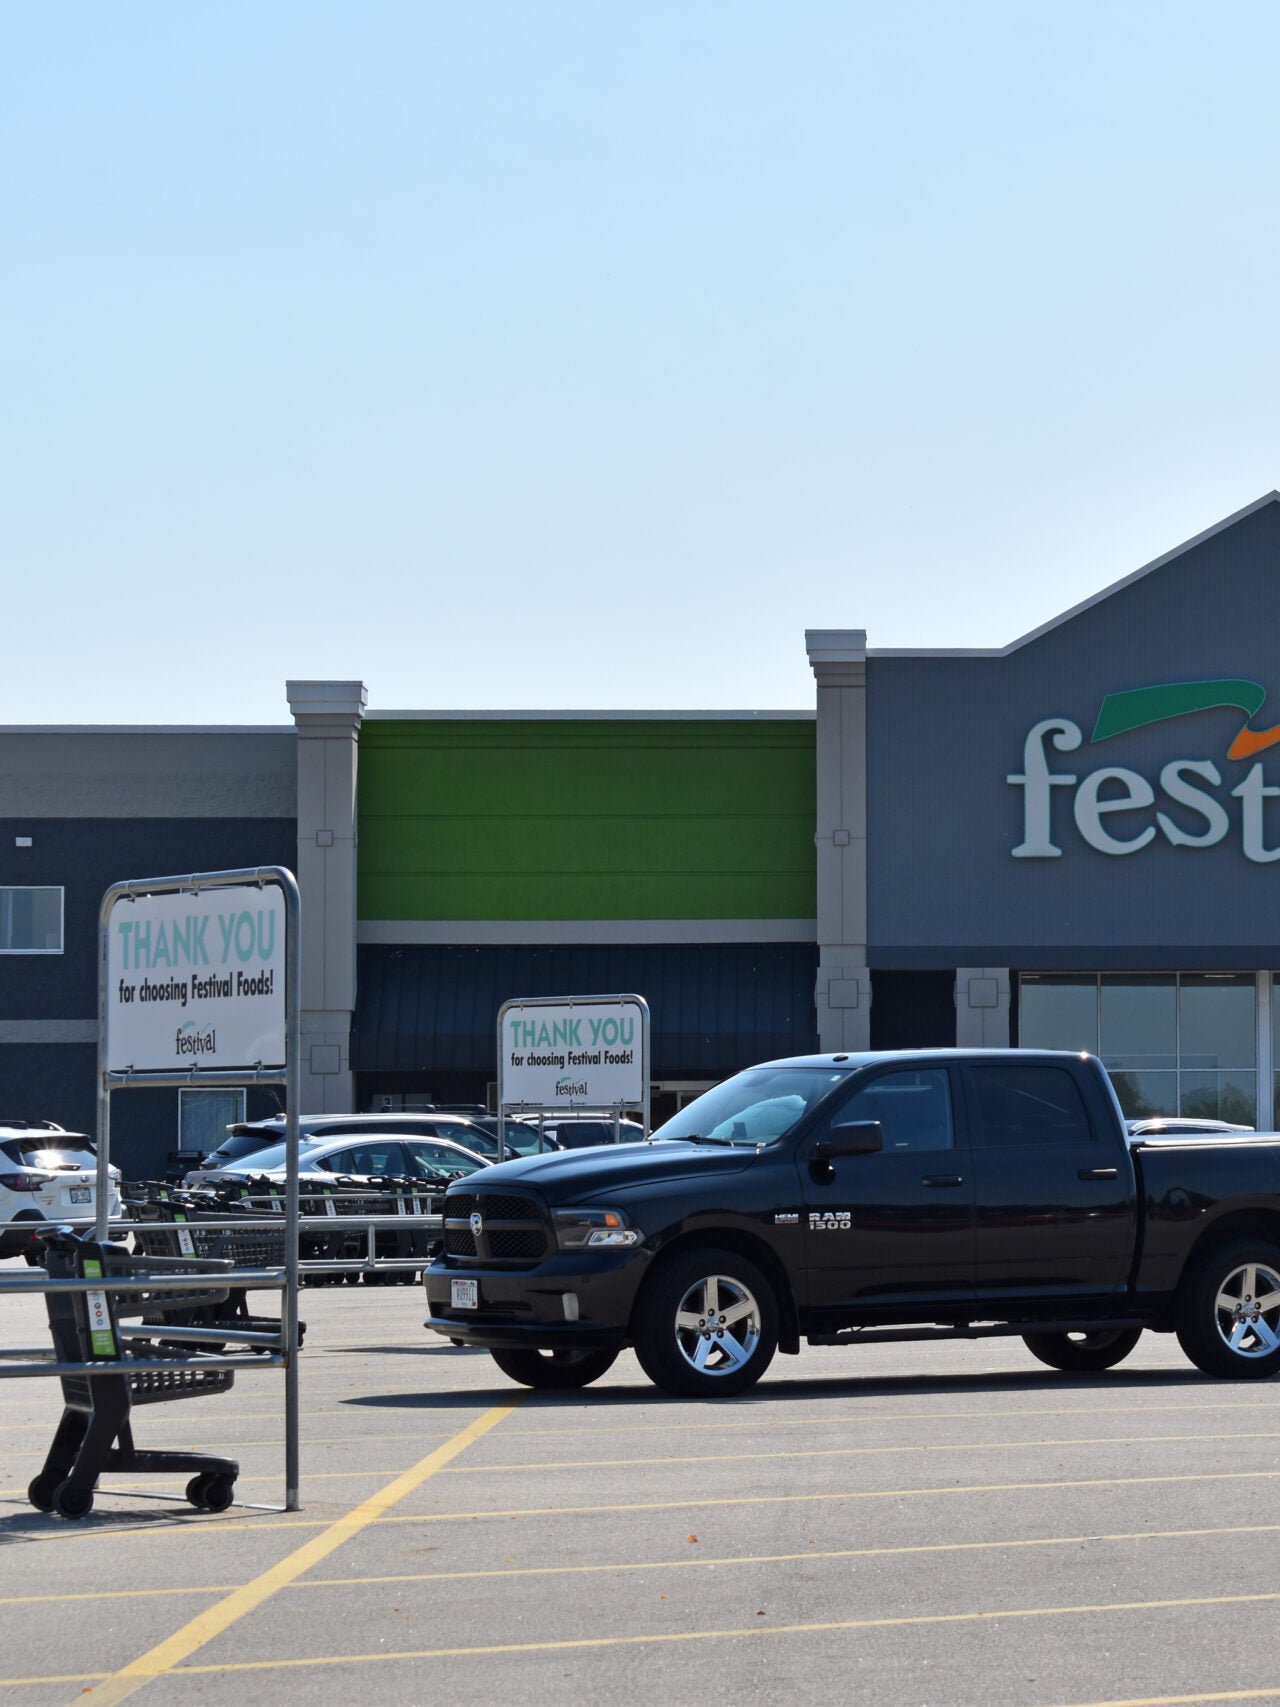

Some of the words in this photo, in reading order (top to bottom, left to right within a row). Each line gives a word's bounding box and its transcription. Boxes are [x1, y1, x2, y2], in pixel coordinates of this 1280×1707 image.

[118, 914, 210, 970] THANK
[218, 909, 275, 964] YOU
[119, 978, 135, 1003] for
[140, 976, 187, 1007] choosing
[191, 972, 233, 999] Festival
[237, 969, 274, 997] Foods!
[175, 1028, 217, 1055] festival
[511, 1019, 582, 1048] THANK
[589, 1017, 634, 1046] YOU
[511, 1053, 524, 1066] for
[527, 1052, 564, 1069] choosing
[568, 1051, 601, 1065] Festival
[604, 1050, 633, 1065] Foods!
[555, 1081, 588, 1096] festival
[809, 1212, 851, 1221] RAM
[809, 1221, 851, 1230] 1500
